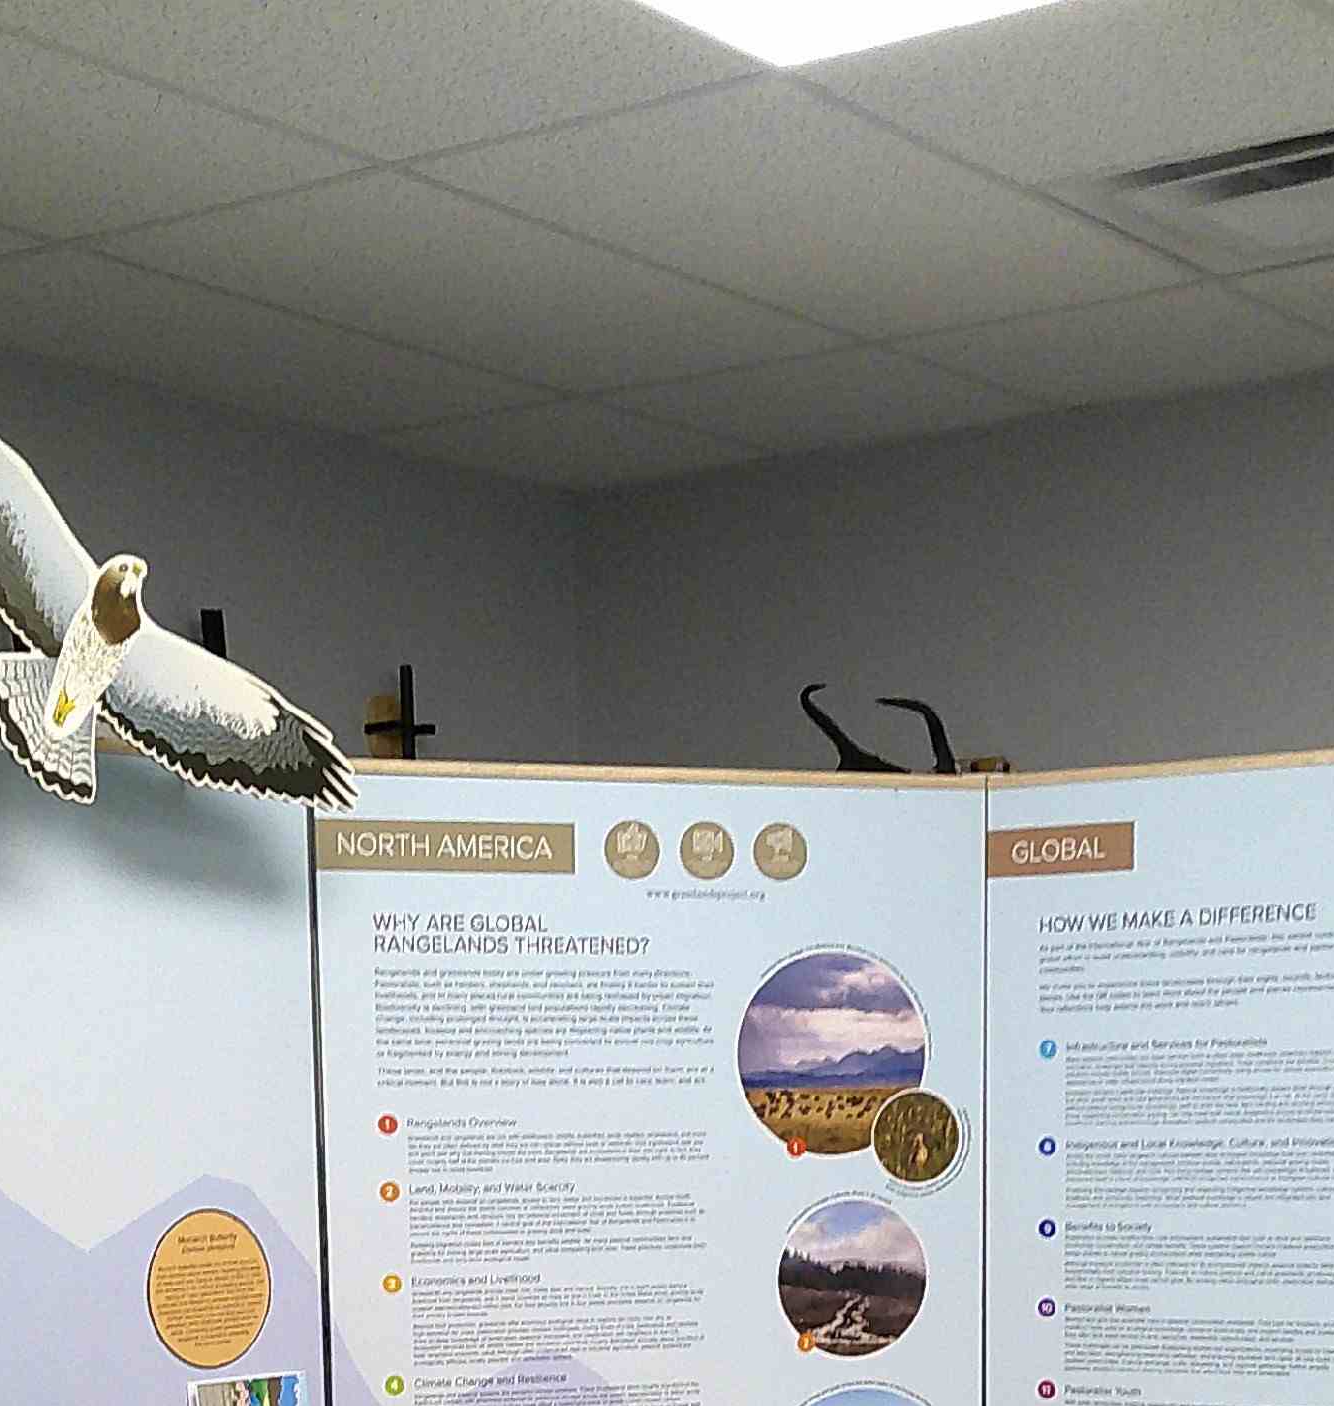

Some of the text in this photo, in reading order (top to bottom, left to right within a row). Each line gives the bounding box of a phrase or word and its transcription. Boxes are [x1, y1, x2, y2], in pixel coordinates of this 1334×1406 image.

[336, 831, 554, 861] NORTH AMERICA
[1011, 837, 1106, 865] GLOBAL
[372, 912, 548, 933] WHY ARE GLOBAL
[1038, 902, 1317, 934] HOW WE MAKE A DIFFERENCE
[373, 934, 650, 956] RANGELANDS THREATENED?
[406, 1116, 517, 1130] Rangelands Overview
[484, 1182, 502, 1193] and
[411, 1275, 466, 1288] Economics
[468, 1273, 487, 1284] and
[414, 1378, 452, 1390] Climate
[455, 1376, 493, 1390] Change
[496, 1375, 515, 1386] and
